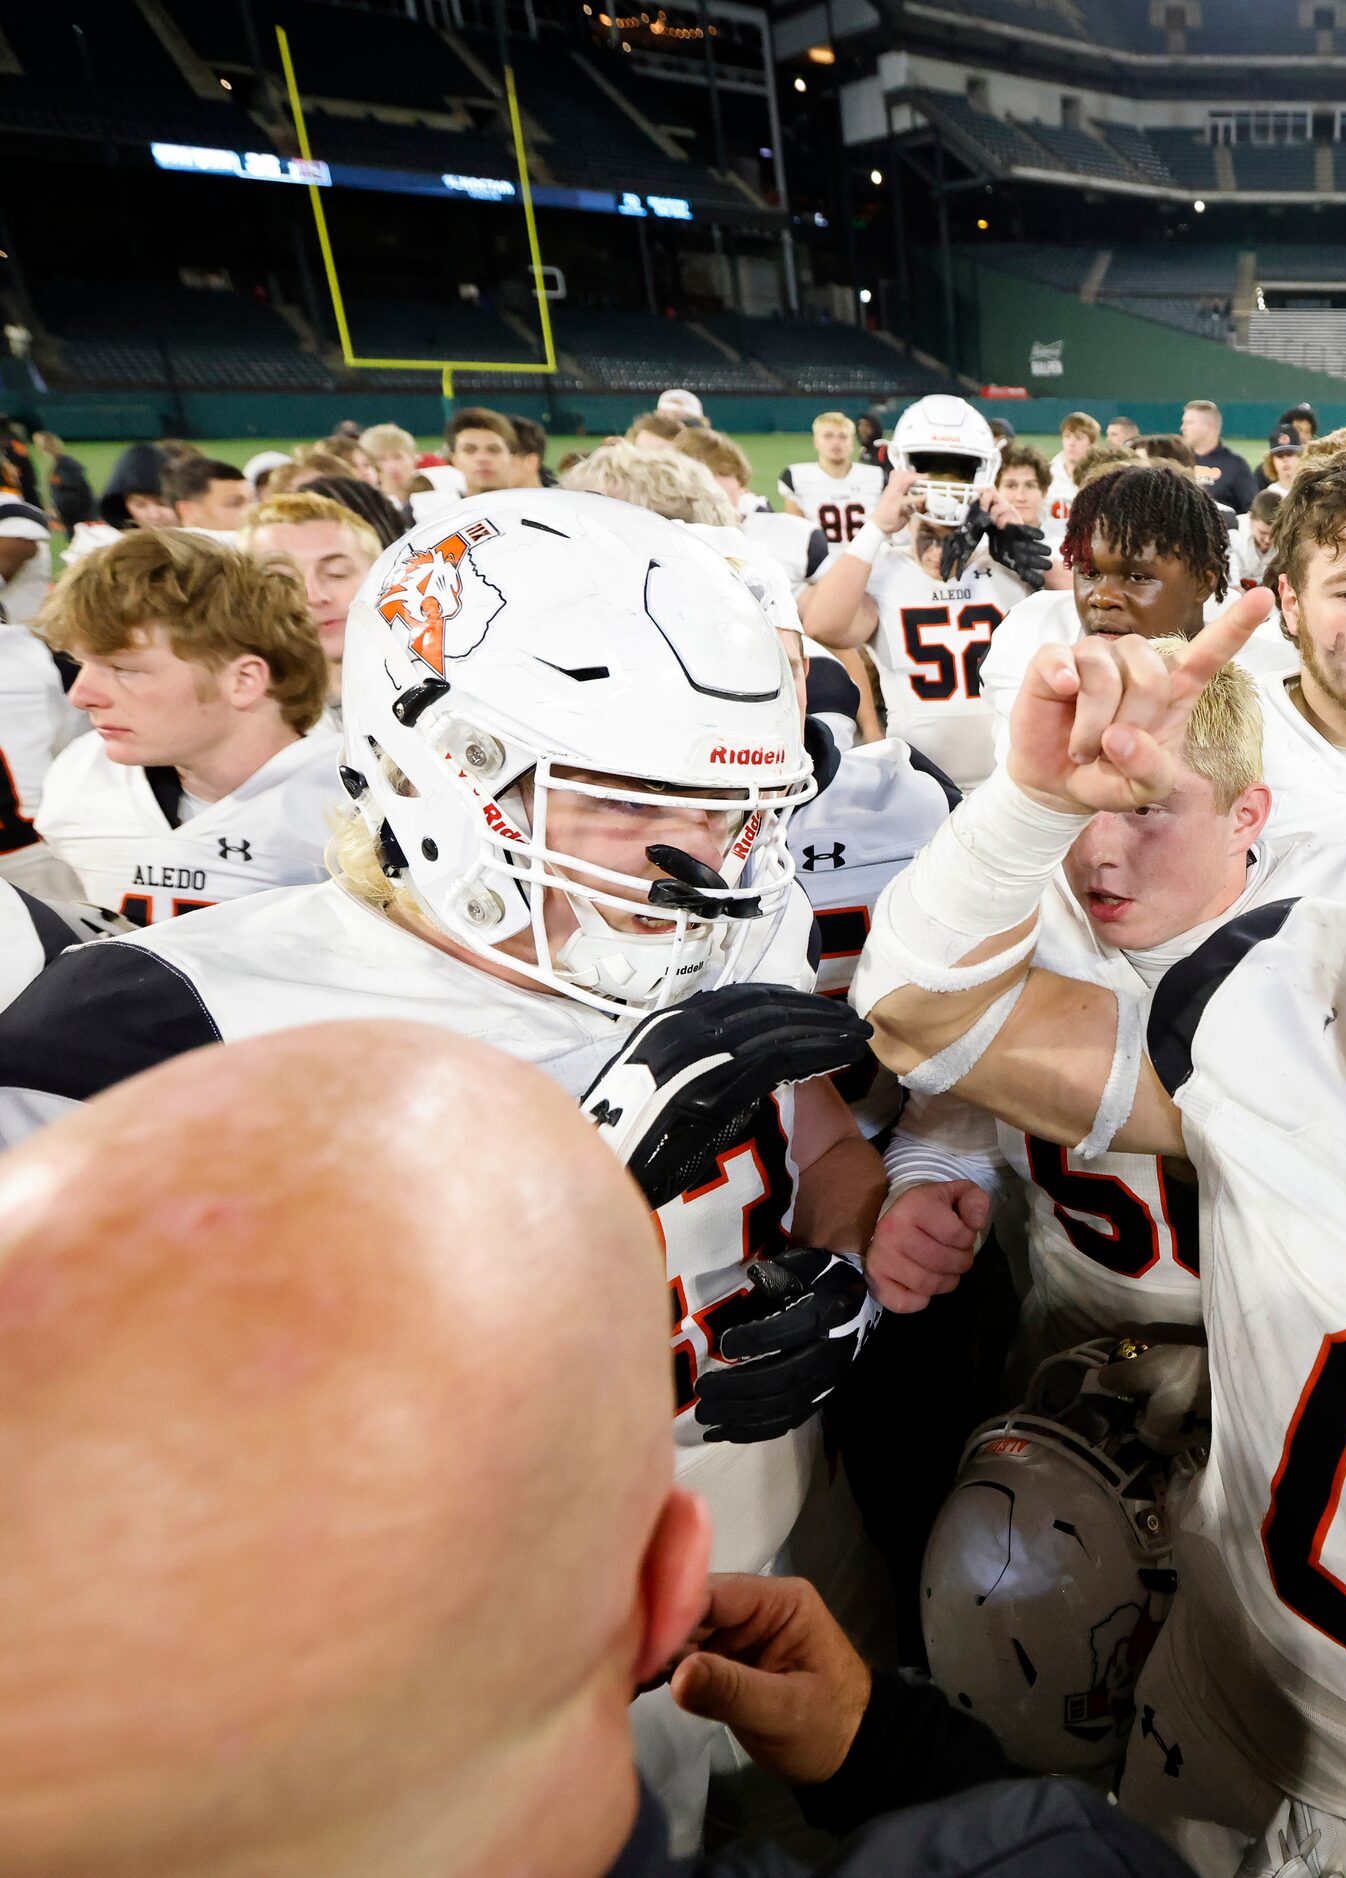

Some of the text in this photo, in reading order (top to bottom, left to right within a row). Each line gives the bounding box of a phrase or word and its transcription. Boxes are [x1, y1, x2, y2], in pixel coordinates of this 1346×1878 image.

[818, 503, 865, 543] 86
[931, 588, 972, 602] ALEDO
[901, 603, 1005, 701] 52
[709, 746, 786, 765] Riddell
[132, 865, 206, 890] ALEDO
